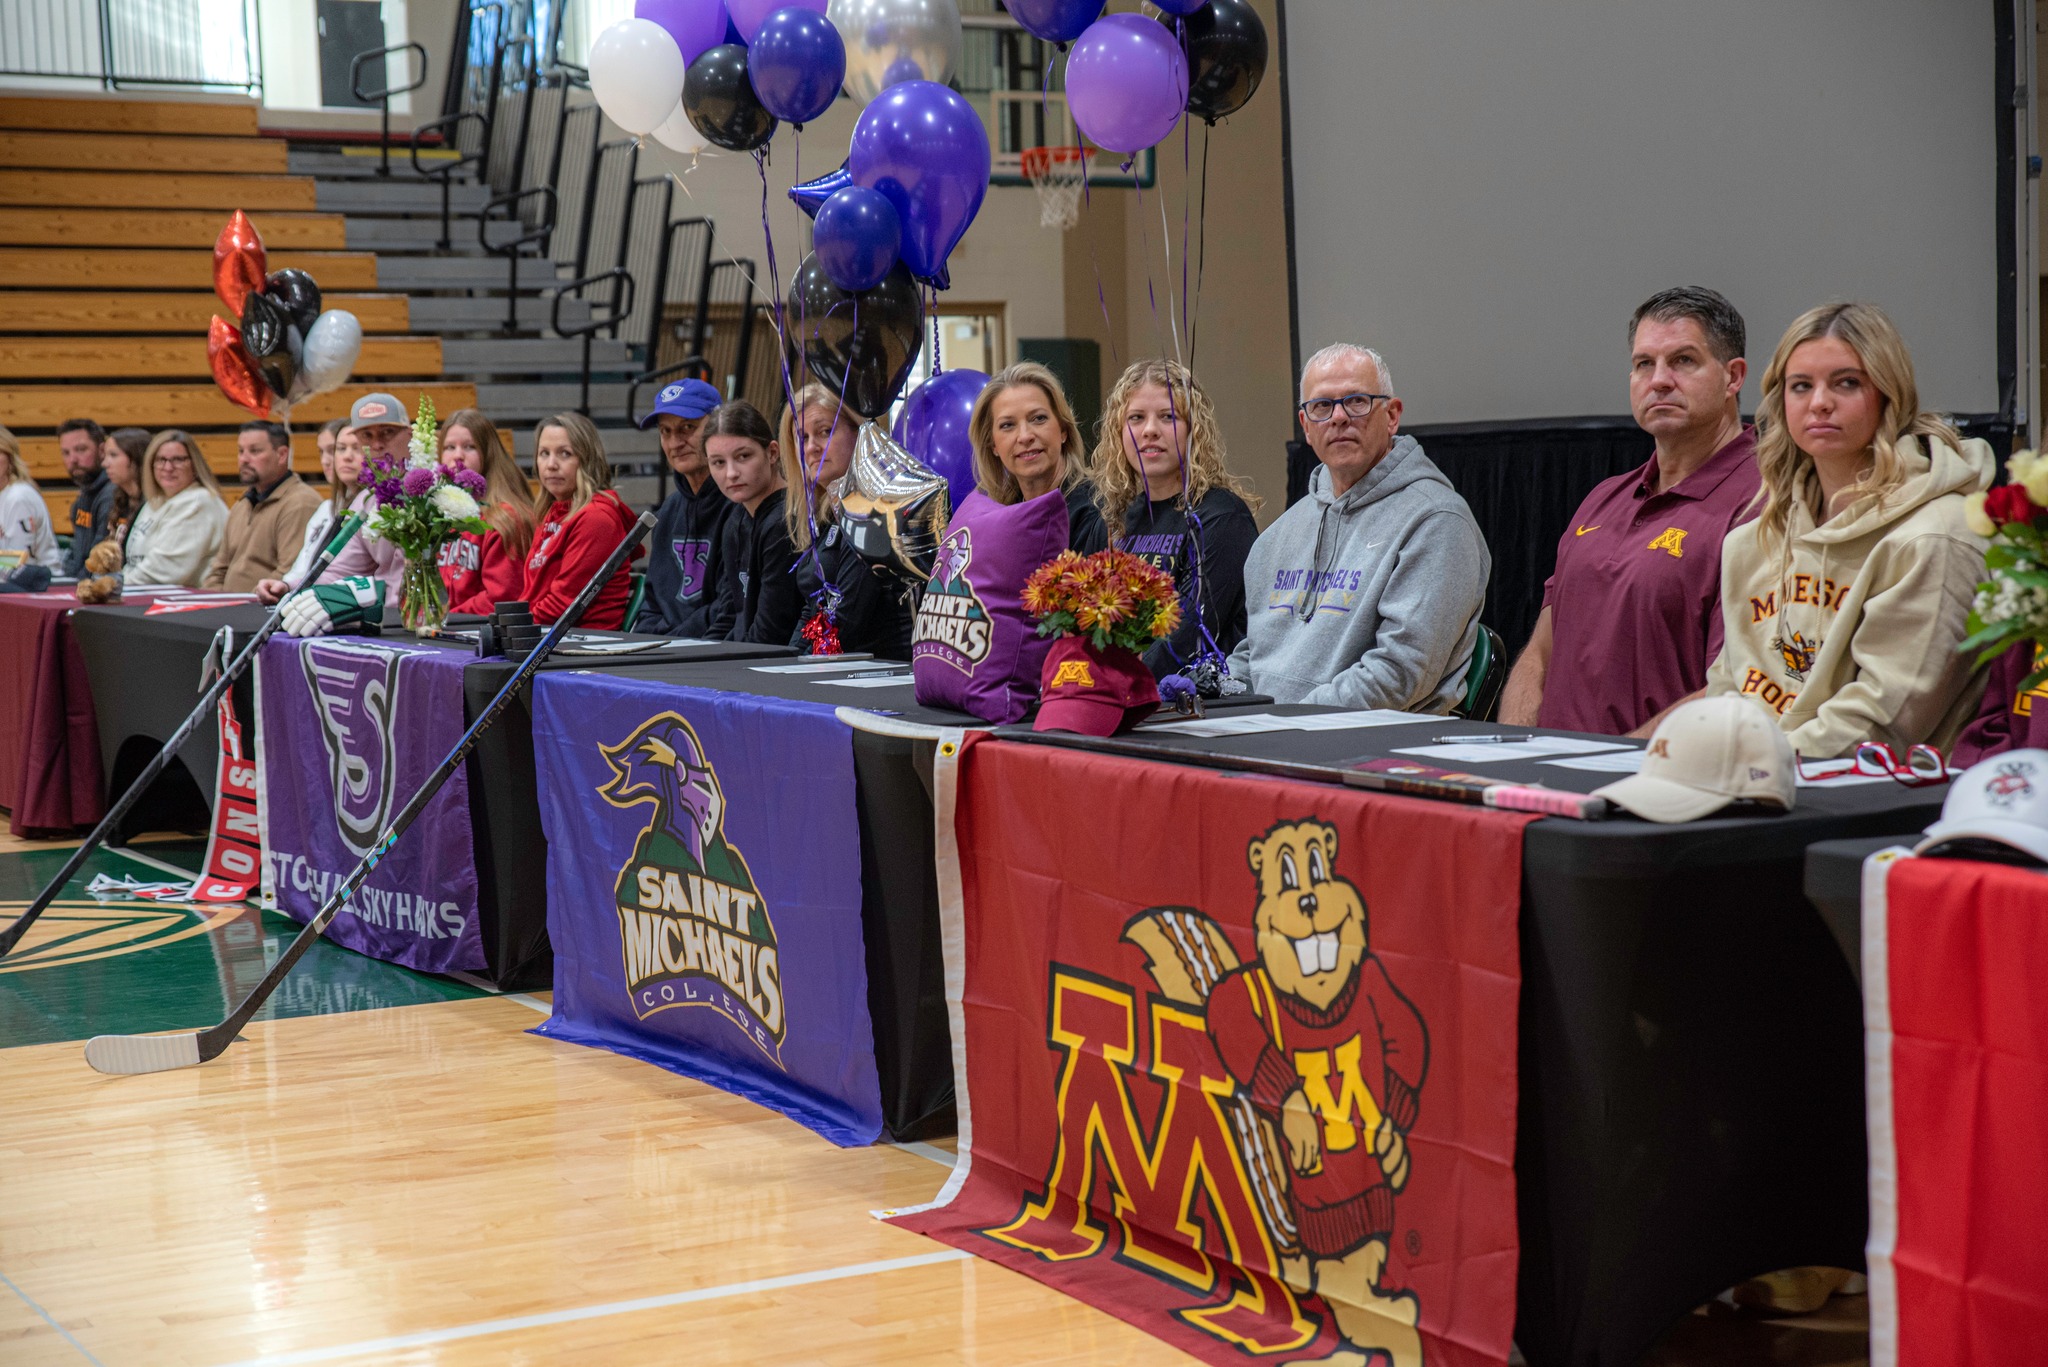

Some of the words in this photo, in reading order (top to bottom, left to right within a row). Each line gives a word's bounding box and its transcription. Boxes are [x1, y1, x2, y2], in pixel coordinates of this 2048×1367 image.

[1647, 527, 1688, 558] M
[1274, 569, 1304, 590] SAINT
[1304, 569, 1362, 592] MCAEL'S
[918, 593, 975, 618] SAINT
[913, 644, 965, 668] OLLEGE
[1051, 661, 1095, 689] M
[361, 884, 466, 939] SKYHAKS
[637, 866, 757, 936] SAINT
[972, 963, 1323, 1355] M
